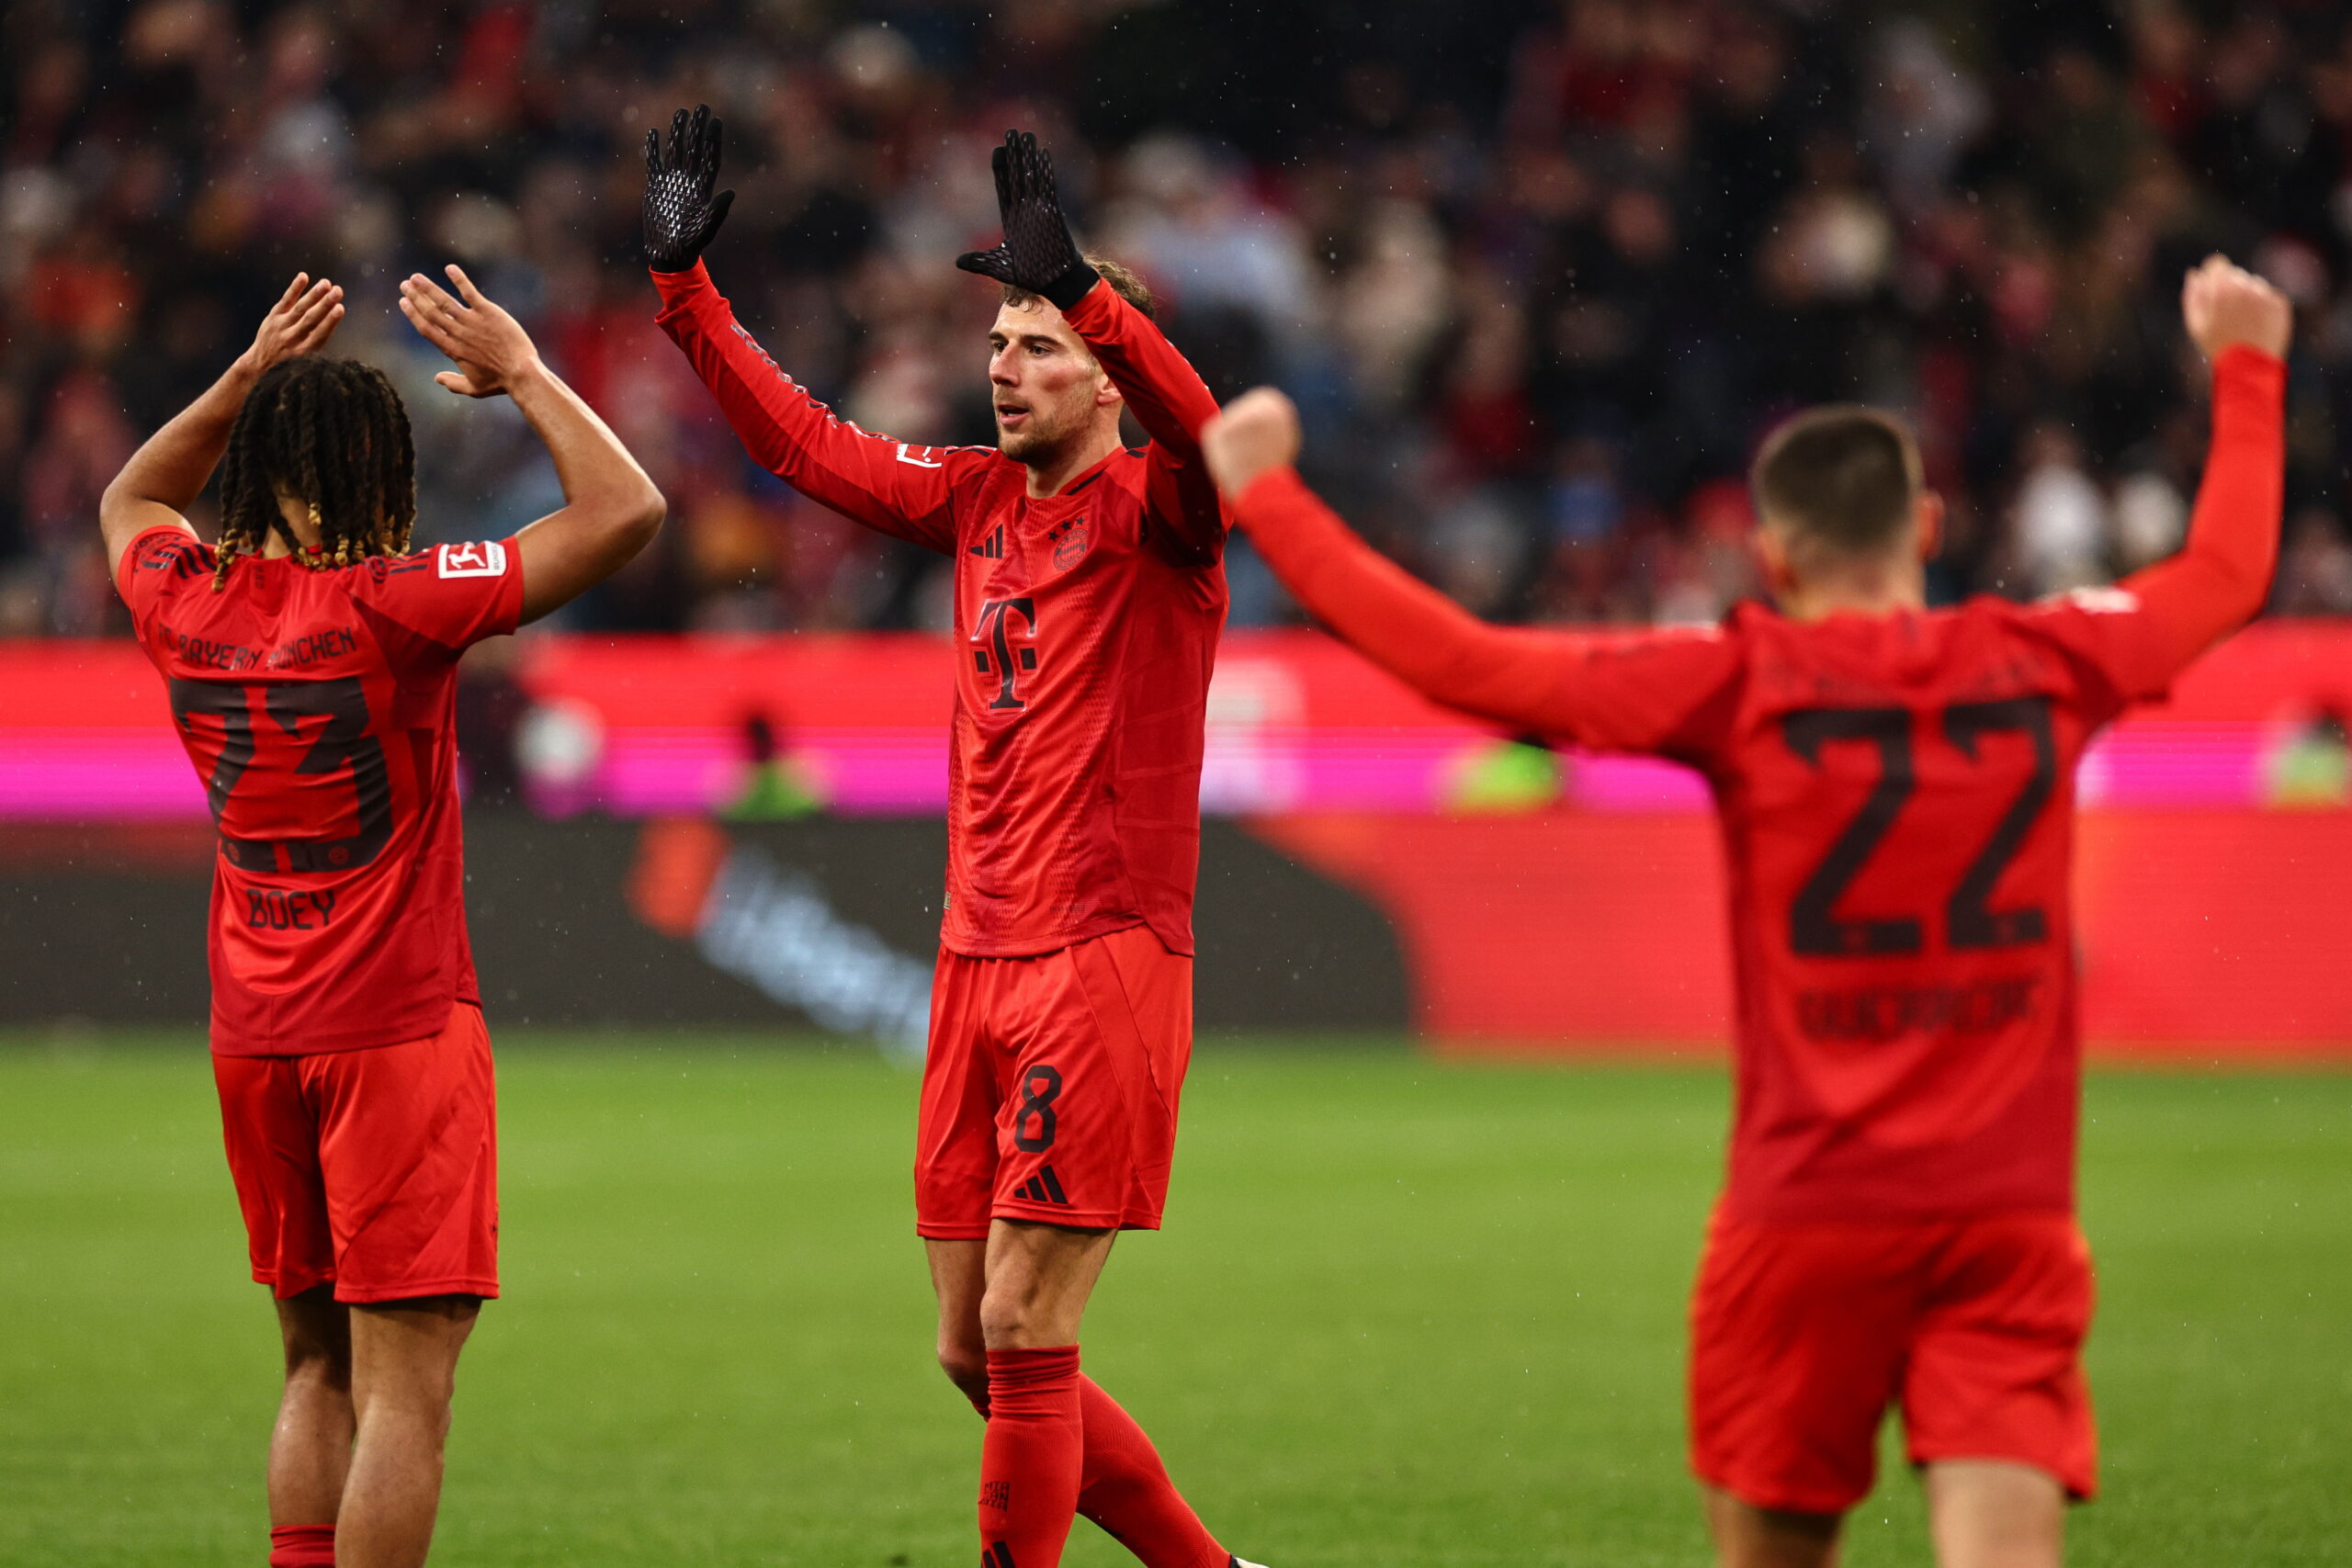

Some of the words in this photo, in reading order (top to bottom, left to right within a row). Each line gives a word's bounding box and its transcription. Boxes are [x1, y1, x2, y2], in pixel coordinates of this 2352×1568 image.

[178, 634, 265, 671] BAYERN
[970, 597, 1038, 710] T
[1781, 694, 2054, 959] 22
[246, 888, 335, 930] BOEY
[1014, 1065, 1062, 1153] 8
